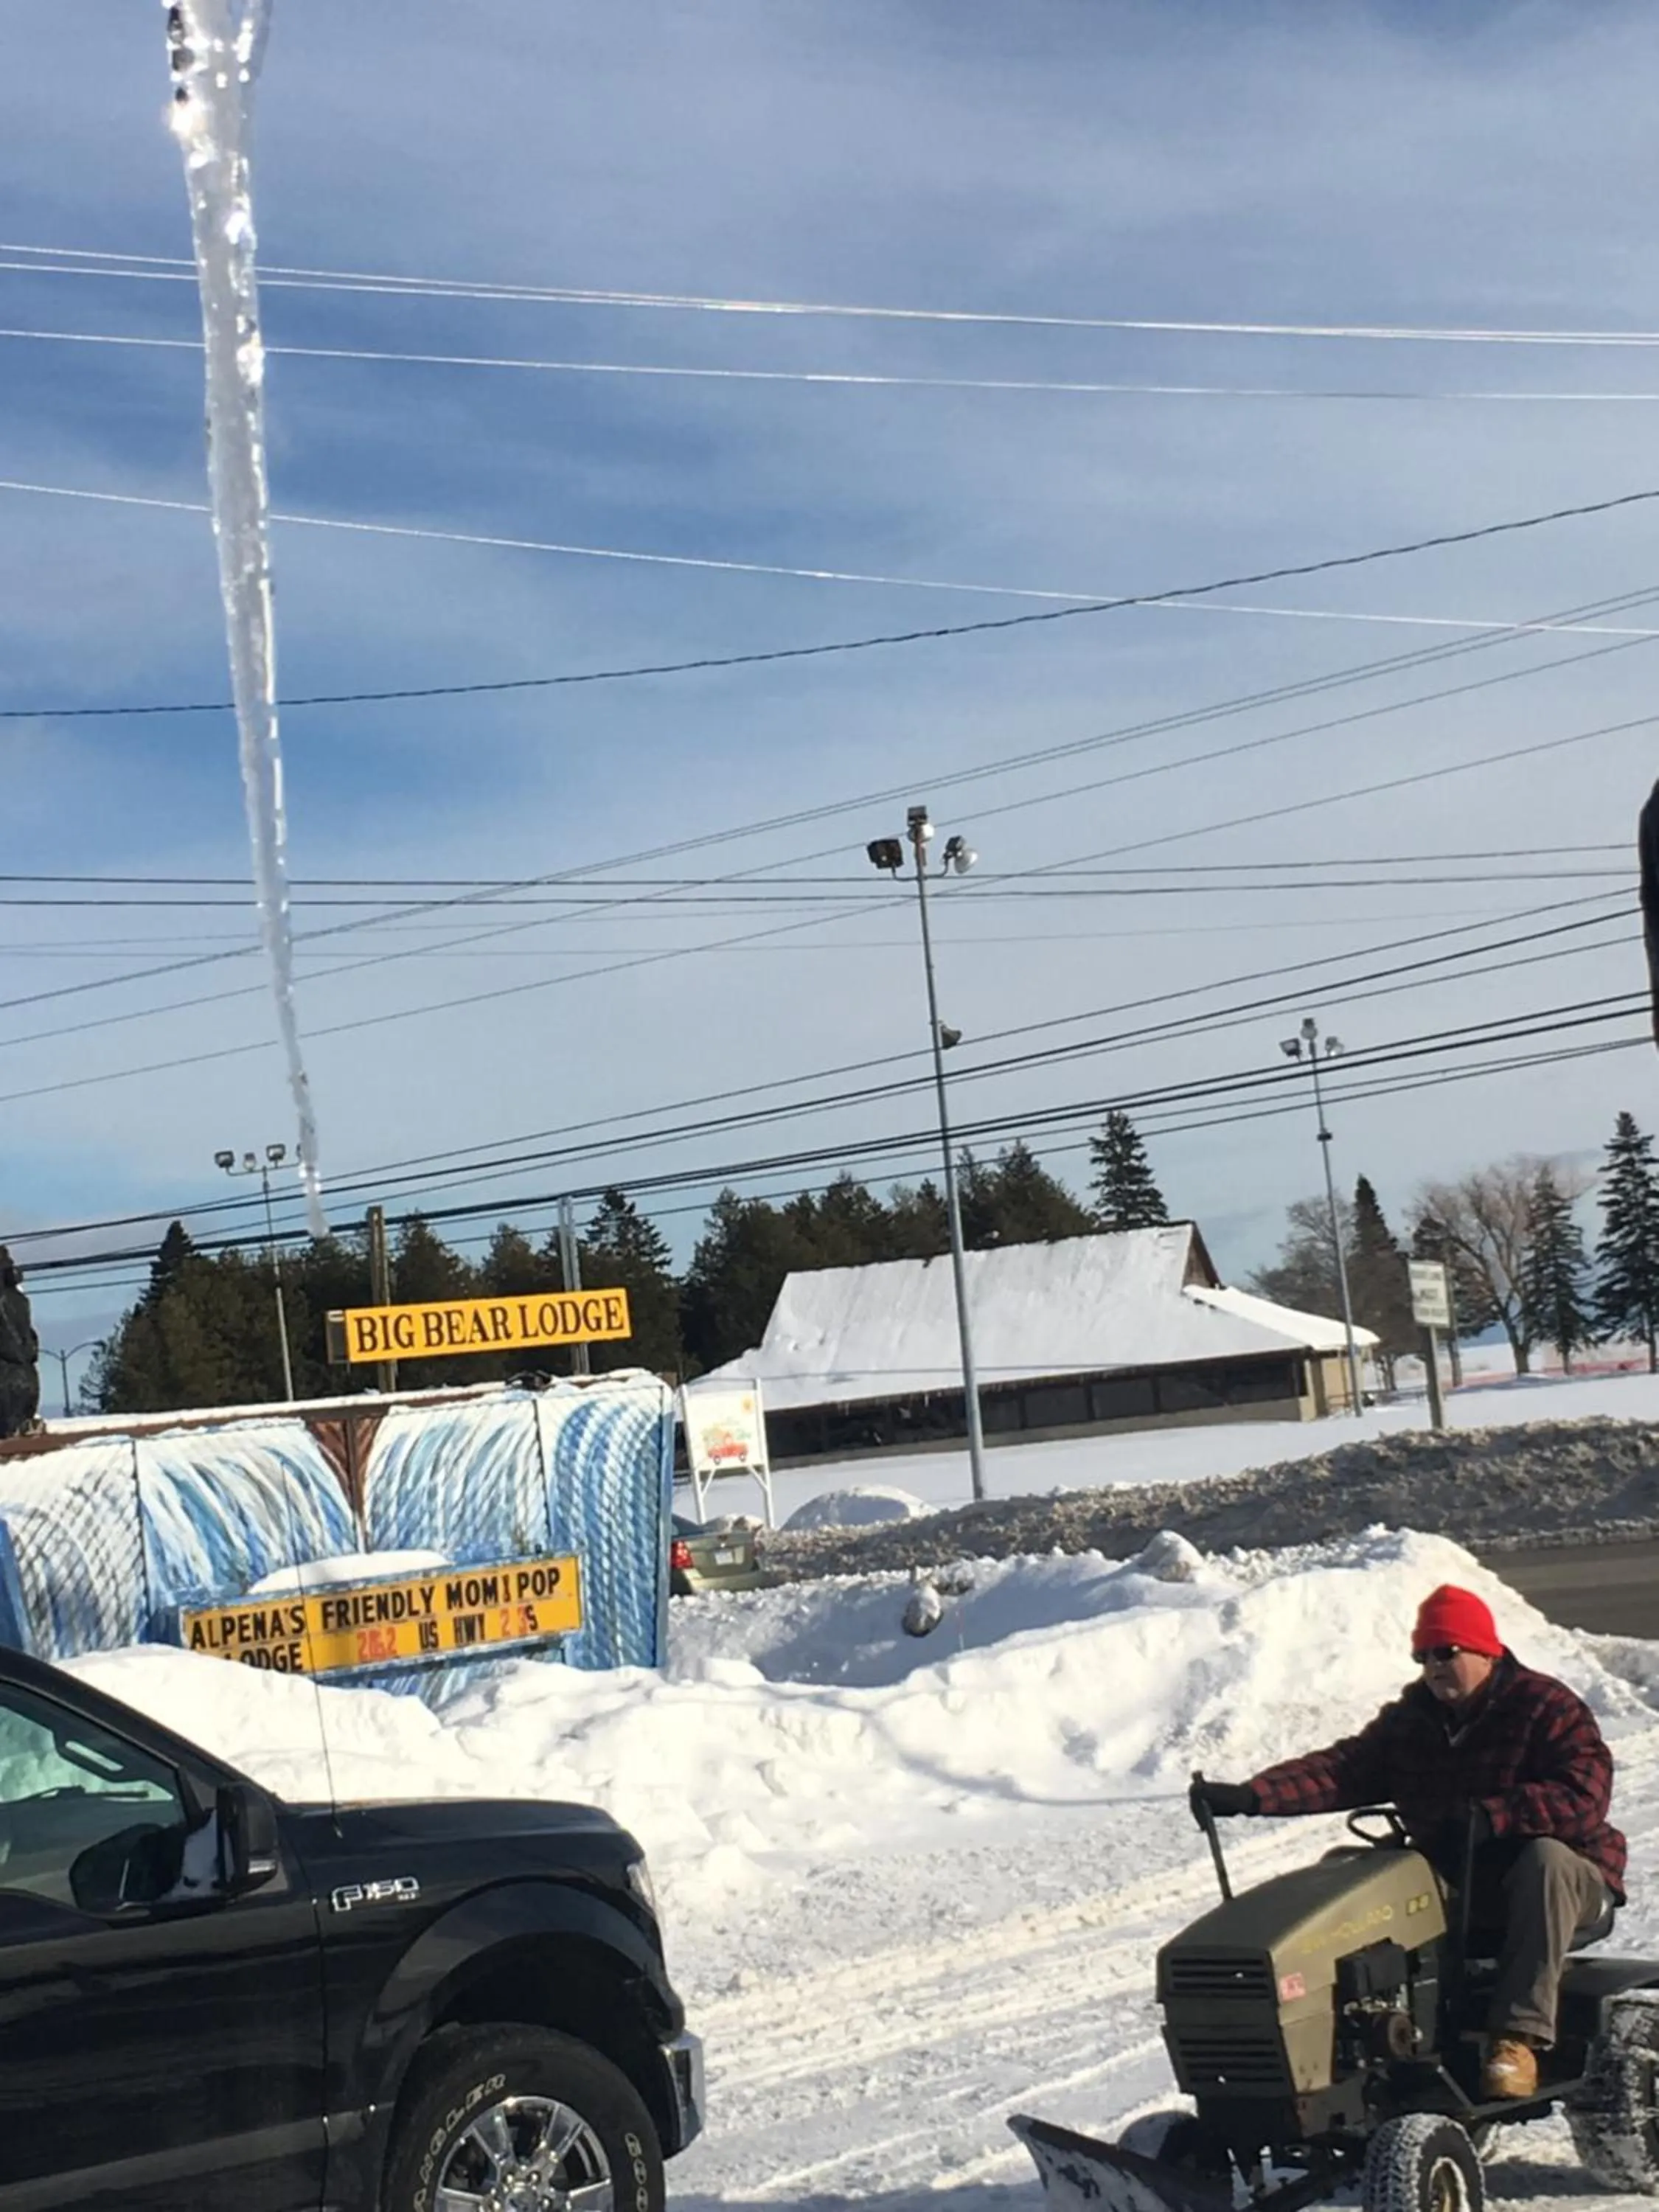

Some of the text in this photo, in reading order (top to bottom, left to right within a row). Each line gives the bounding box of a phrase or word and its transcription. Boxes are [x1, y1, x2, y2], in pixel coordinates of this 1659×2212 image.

[355, 1296, 625, 1353] BIG BEAR LODGE
[189, 1605, 305, 1650] ALPENA'S
[321, 1585, 435, 1630] FRIENDLY
[445, 1576, 498, 1610] MOM
[517, 1566, 560, 1599] POP
[224, 1642, 303, 1672] ODGE
[418, 1620, 439, 1649] US
